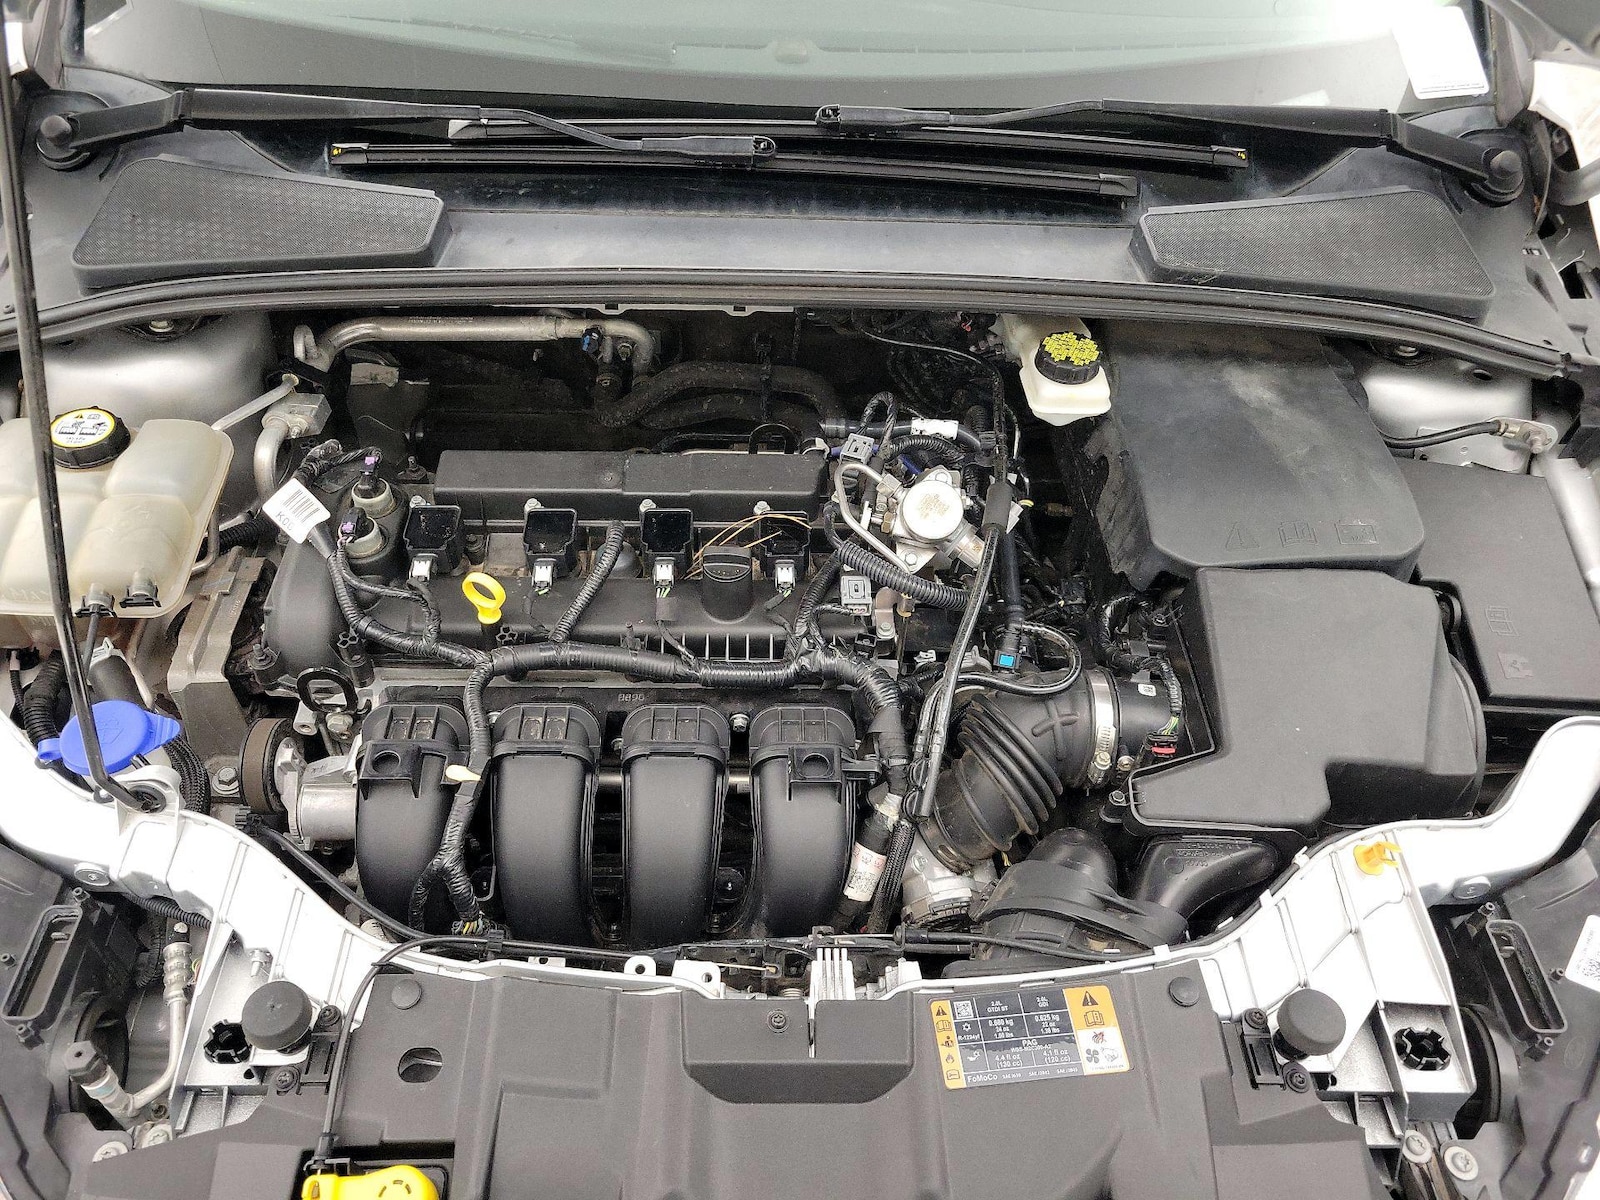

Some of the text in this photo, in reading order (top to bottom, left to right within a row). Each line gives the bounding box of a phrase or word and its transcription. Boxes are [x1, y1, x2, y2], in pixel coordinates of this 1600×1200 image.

[1005, 1018, 1014, 1026] kg
[1052, 1014, 1060, 1022] kg
[1022, 1039, 1038, 1047] PAG
[996, 1059, 1023, 1069] (130 cc)
[1044, 1054, 1071, 1065] (120 cc)
[967, 1073, 998, 1083] FoMoCo
